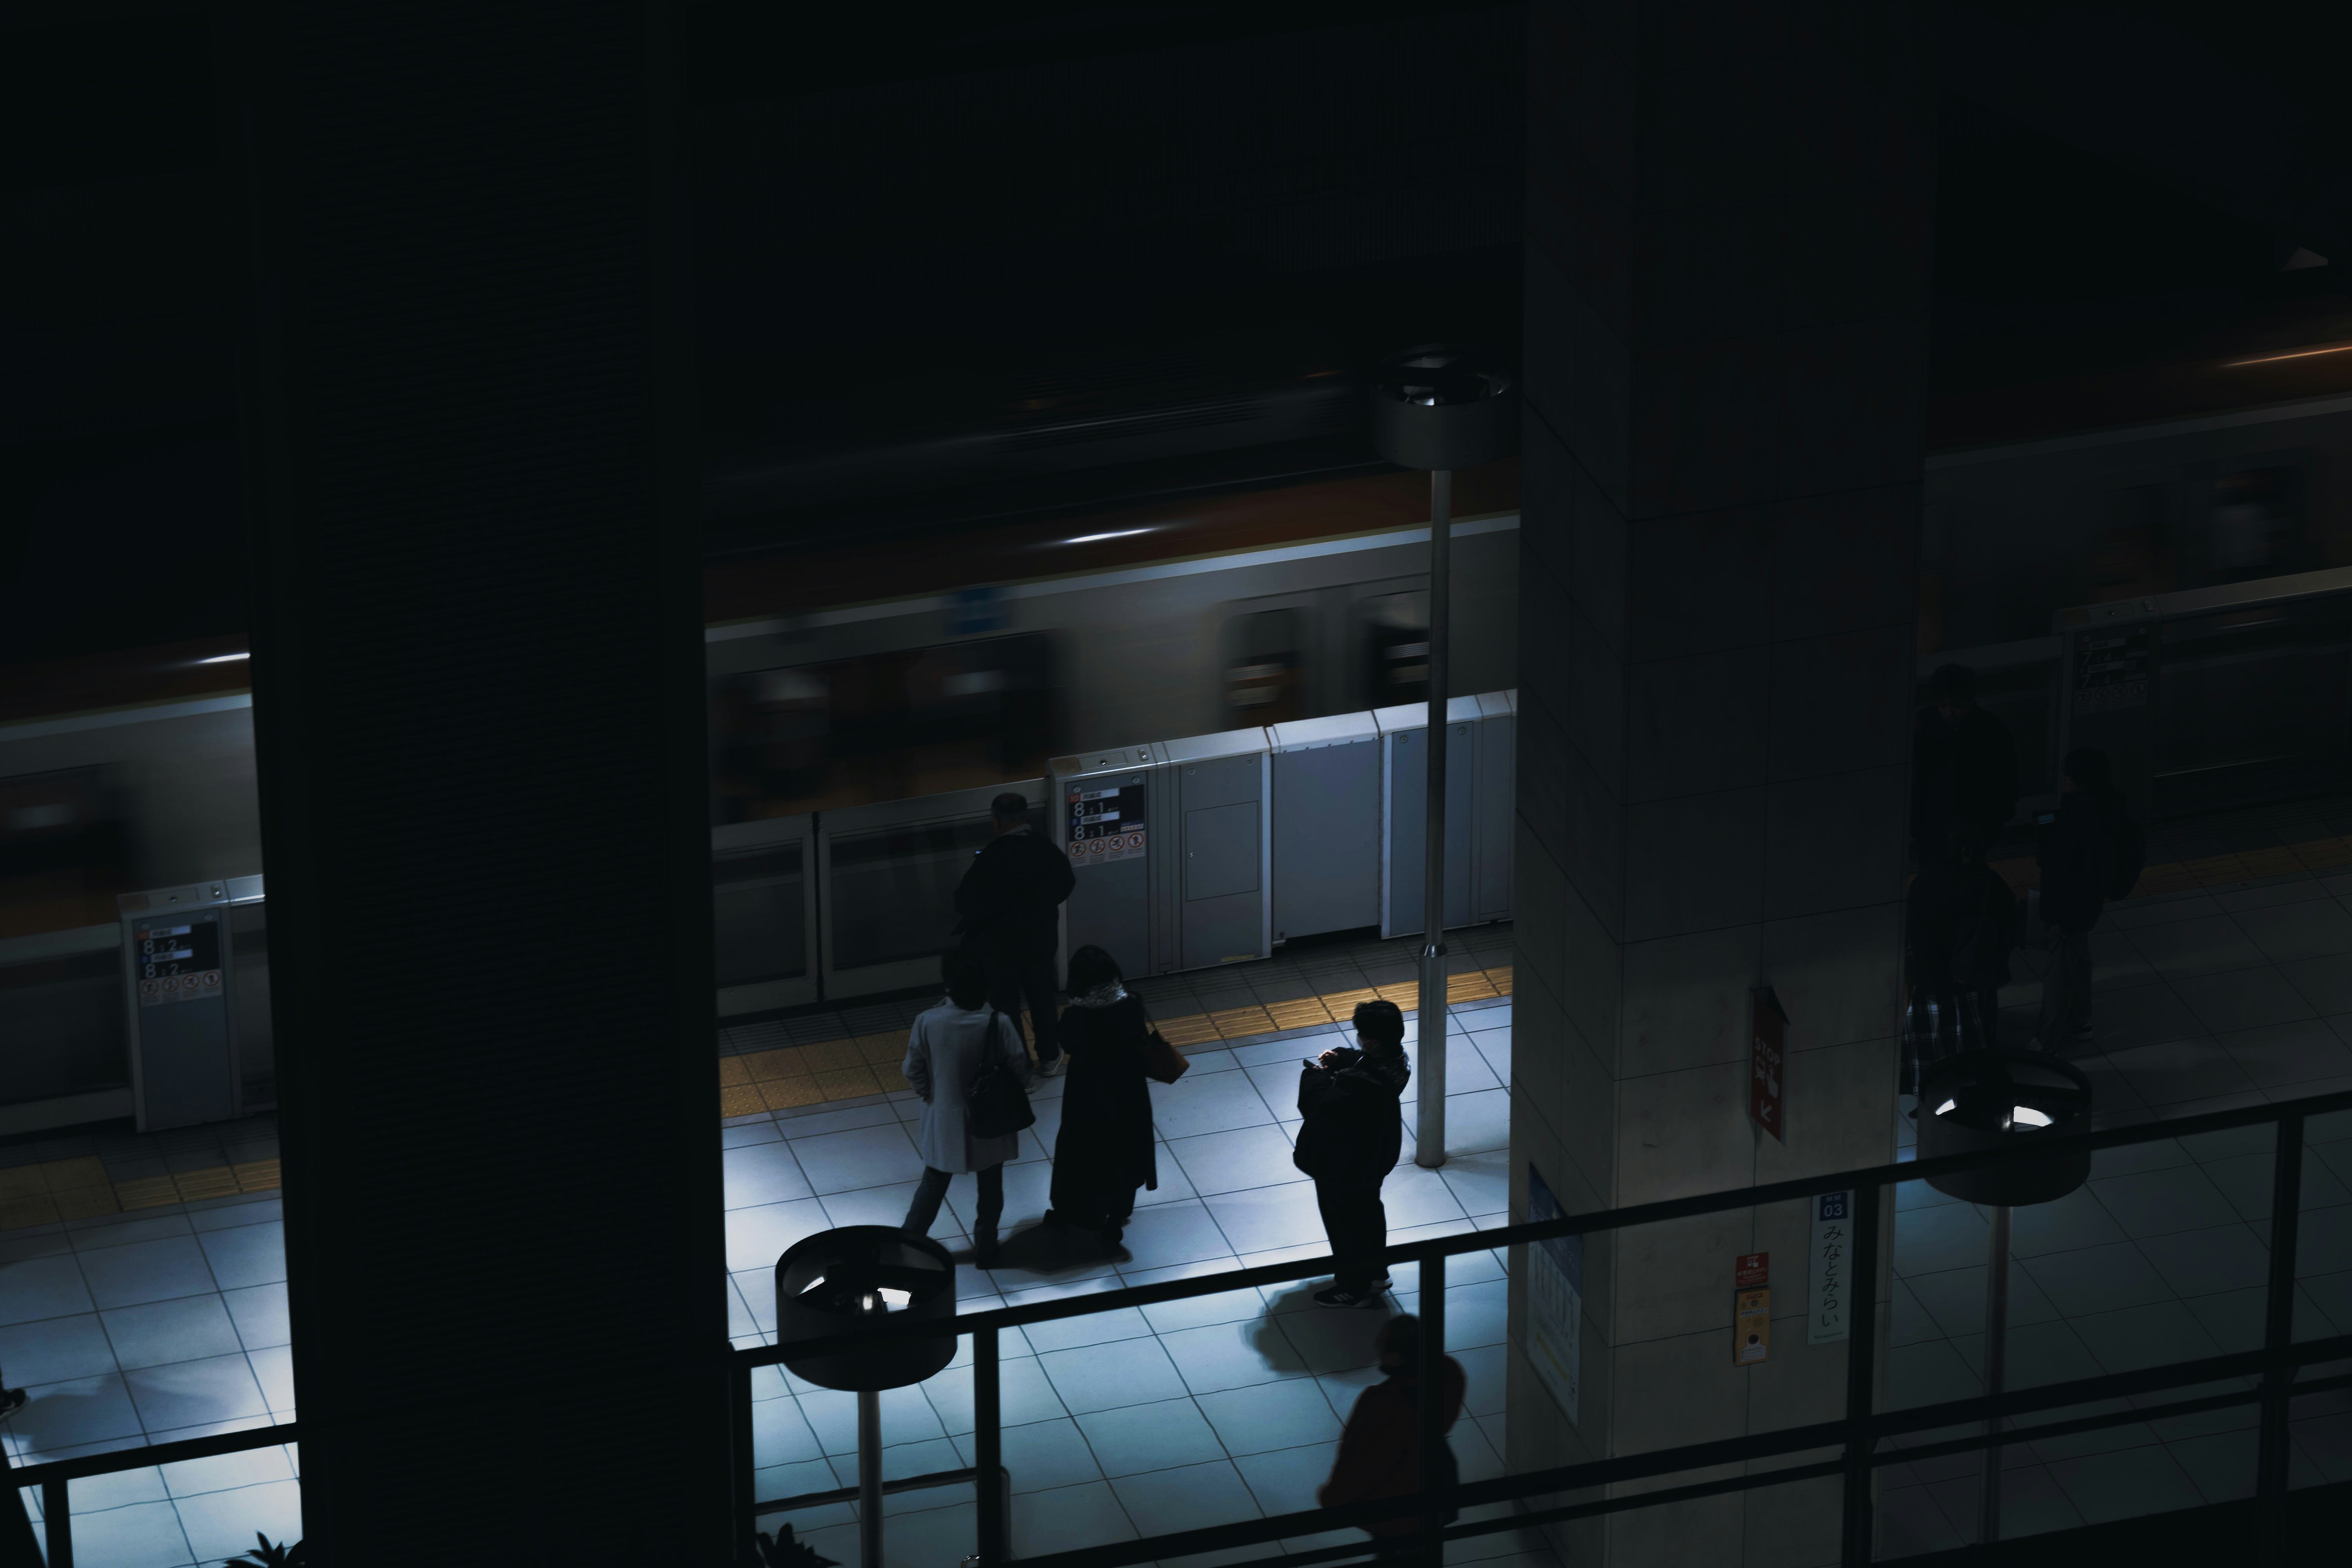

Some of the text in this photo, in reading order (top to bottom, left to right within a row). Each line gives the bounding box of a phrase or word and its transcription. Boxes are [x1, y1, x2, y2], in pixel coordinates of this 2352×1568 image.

[2082, 651, 2111, 666] 7 4
[2082, 674, 2111, 688] 7 4
[1074, 802, 1085, 817] 8
[1098, 802, 1103, 813] 1
[1074, 826, 1085, 840] 8
[1098, 826, 1104, 837] 1
[143, 940, 155, 955] 8
[168, 939, 177, 951] 2
[145, 963, 156, 978] 8
[169, 963, 179, 976] 2
[1755, 1036, 1781, 1066] STOP
[1824, 1203, 1843, 1217] 03
[1822, 1225, 1844, 1327] みなとみらい
